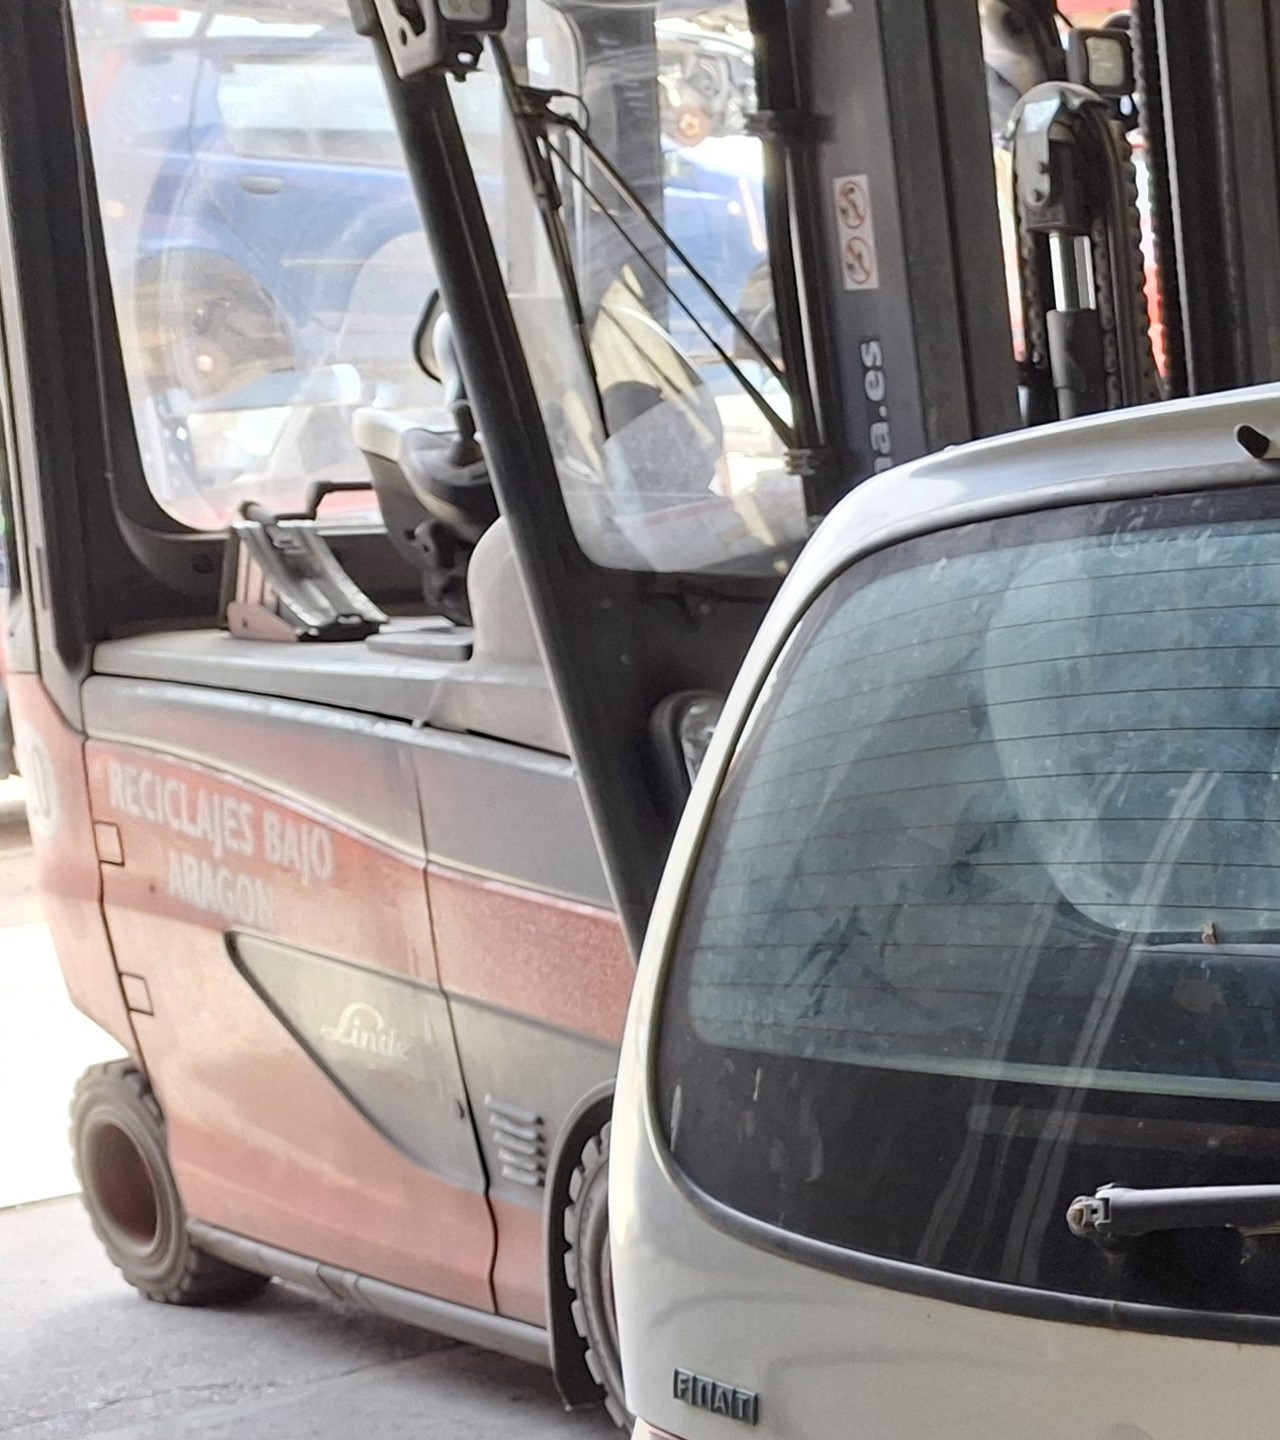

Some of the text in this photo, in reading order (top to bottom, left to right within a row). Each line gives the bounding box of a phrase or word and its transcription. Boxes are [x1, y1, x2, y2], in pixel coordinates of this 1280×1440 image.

[108, 760, 255, 858] RECICLAJES
[262, 808, 334, 886] BAJO
[673, 1367, 759, 1426] FIAT
